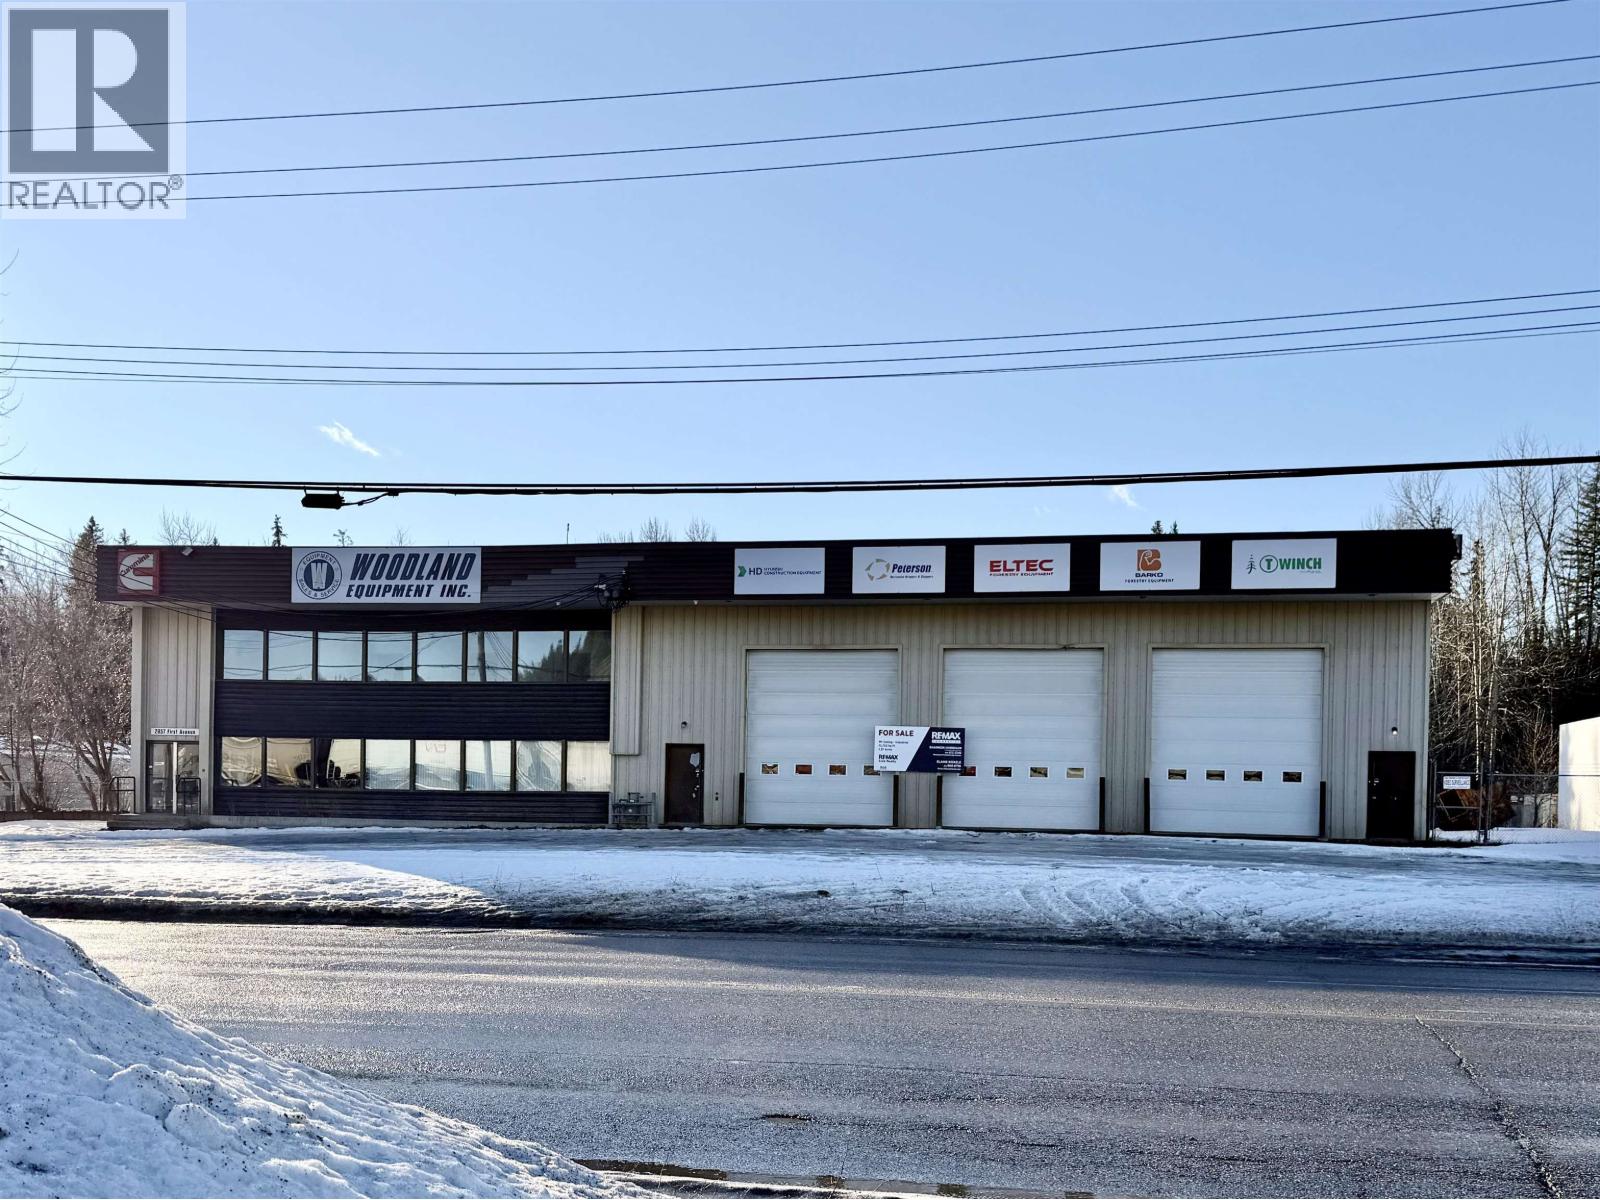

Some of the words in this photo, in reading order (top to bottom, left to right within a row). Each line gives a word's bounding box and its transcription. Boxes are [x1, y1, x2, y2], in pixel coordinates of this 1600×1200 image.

[120, 553, 150, 577] Cummins
[302, 553, 336, 566] EQUIPMENT
[989, 559, 1054, 573] ELTEC
[350, 553, 477, 581] WOODLAND
[748, 567, 763, 576] HD
[891, 563, 932, 574] Peterson
[346, 584, 434, 599] EQUIPMENT
[440, 584, 472, 598] INC.
[878, 729, 894, 737] FOR
[895, 729, 915, 737] SALE
